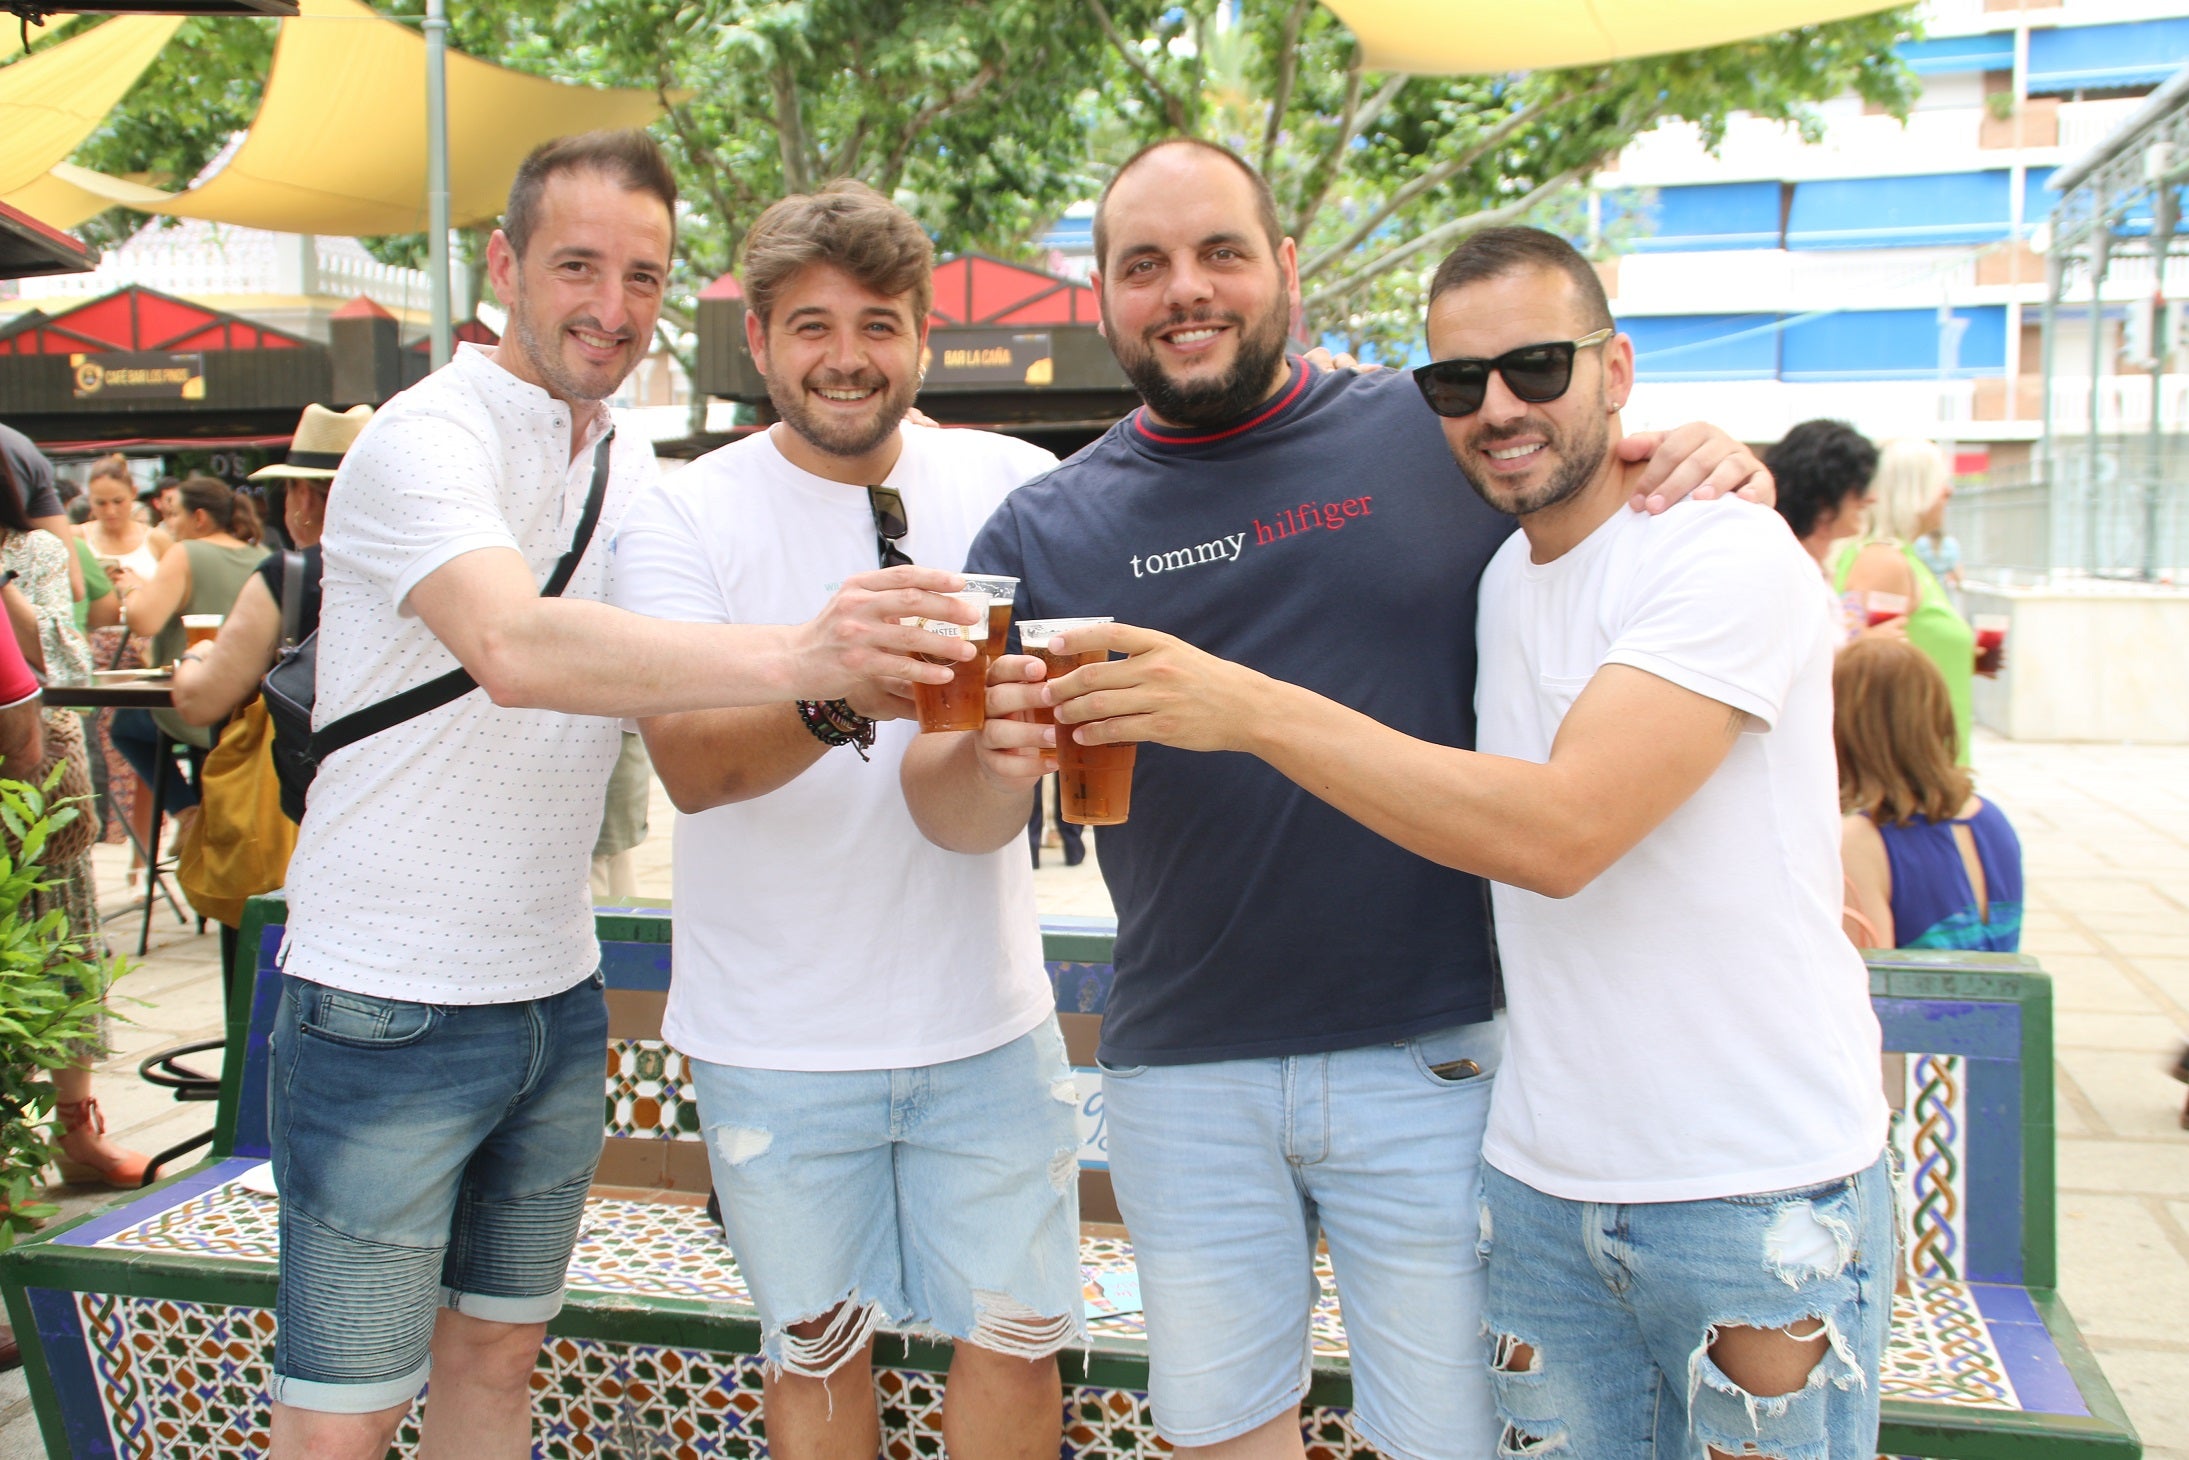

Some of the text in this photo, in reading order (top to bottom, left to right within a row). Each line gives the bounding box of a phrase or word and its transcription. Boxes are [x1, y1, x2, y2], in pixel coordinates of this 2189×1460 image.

[944, 346, 1011, 368] BAR LA CAÑA
[105, 368, 127, 385] CAFÉ
[128, 368, 146, 384] BAR
[1129, 496, 1372, 578] tommy hilfiger
